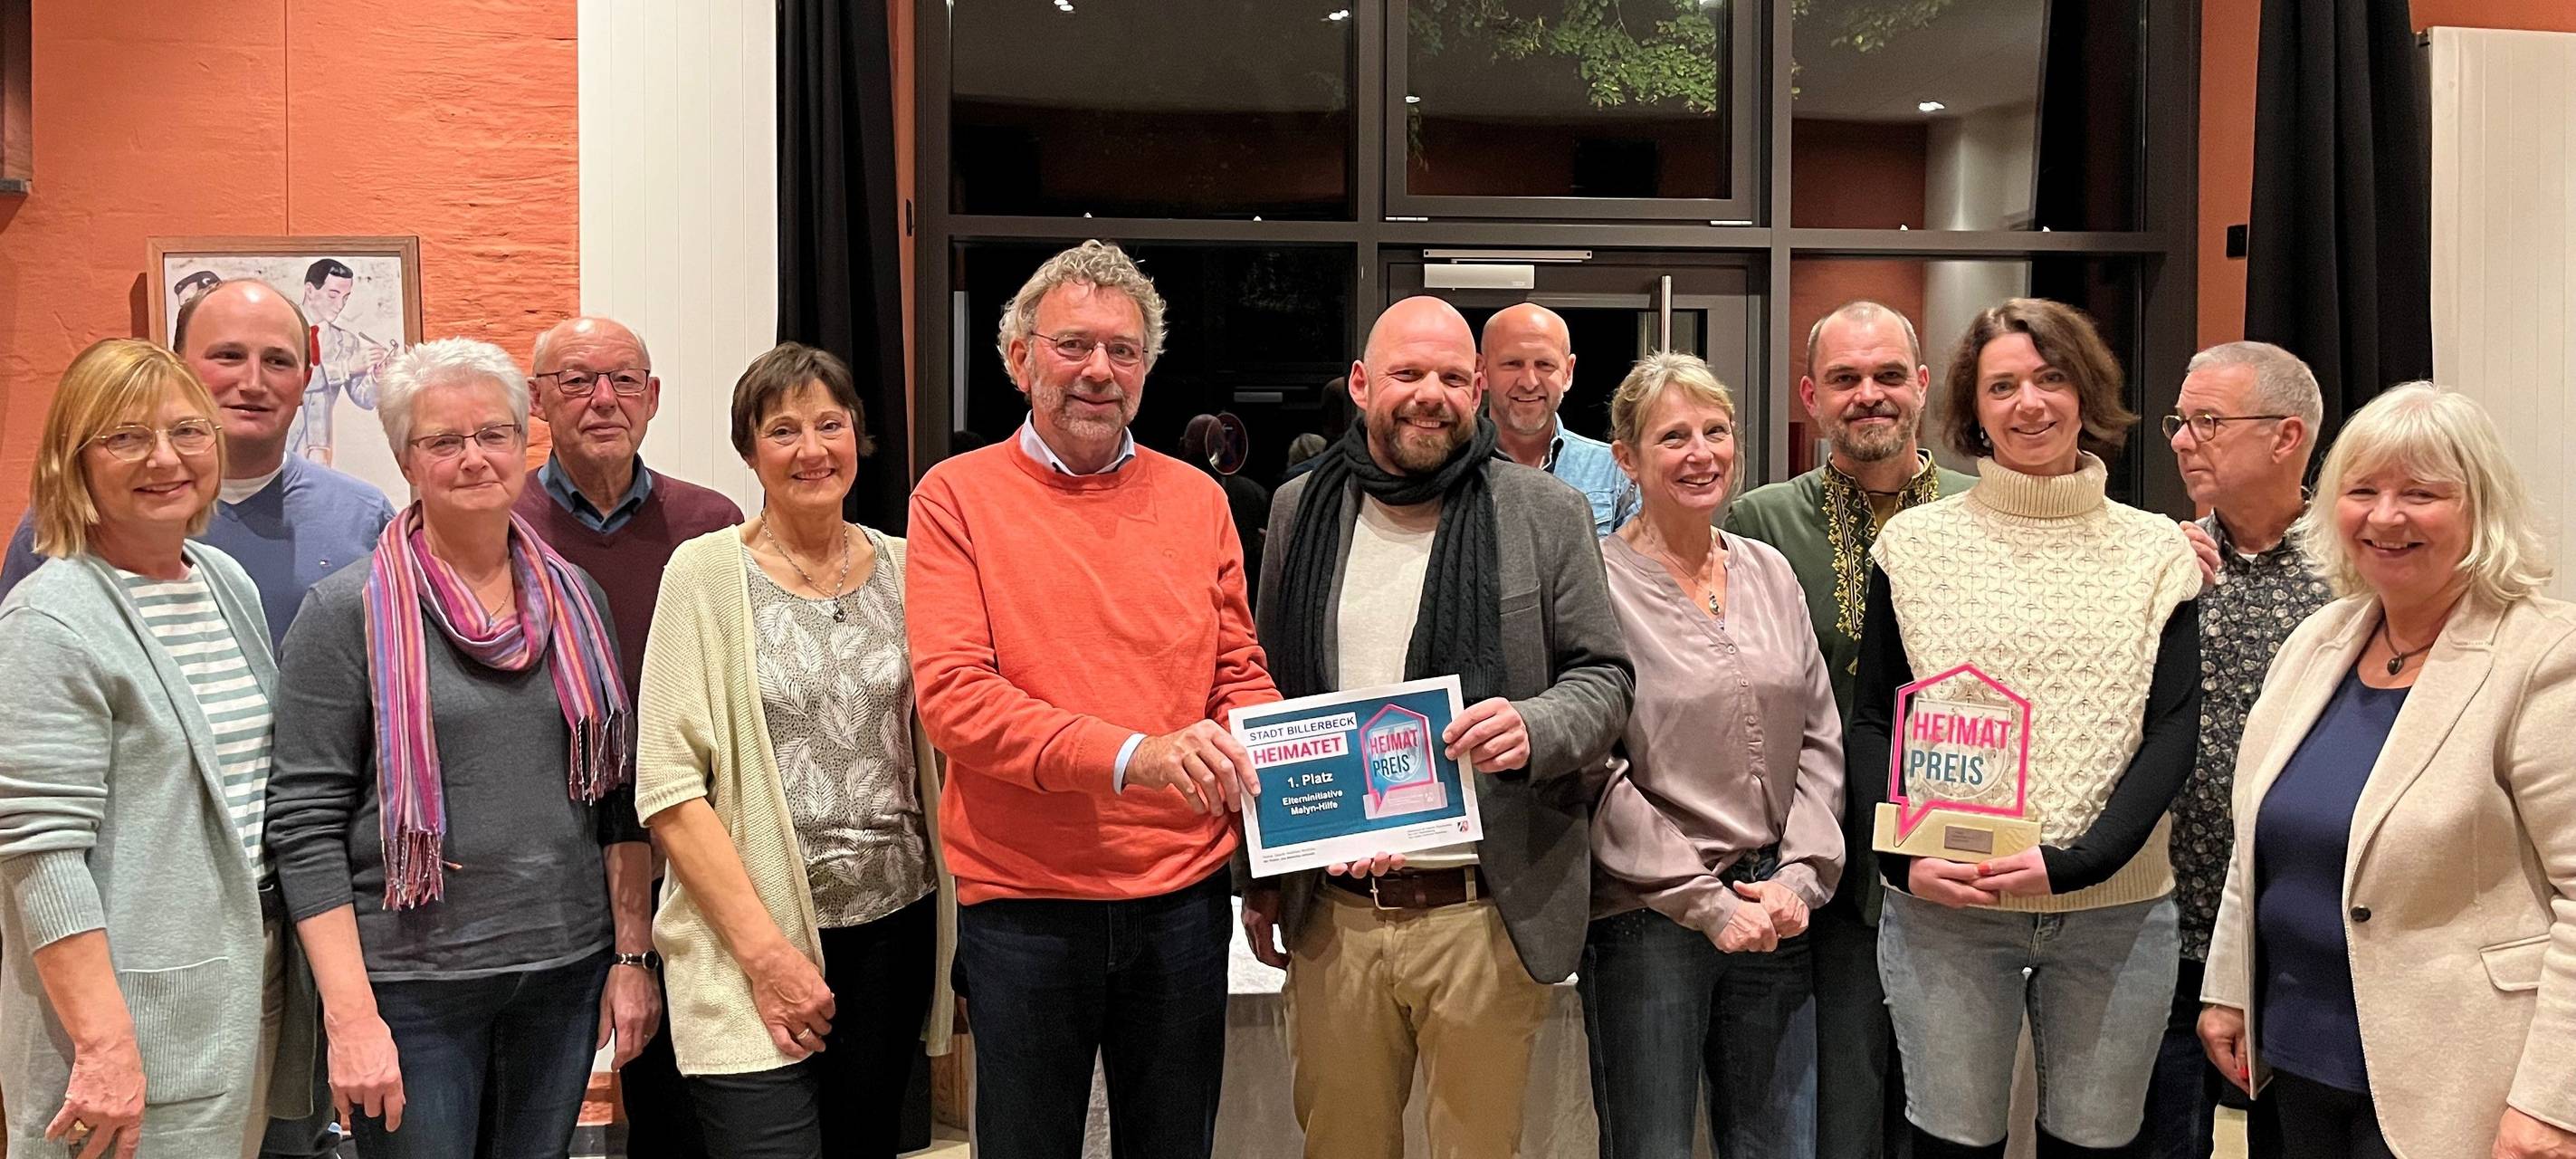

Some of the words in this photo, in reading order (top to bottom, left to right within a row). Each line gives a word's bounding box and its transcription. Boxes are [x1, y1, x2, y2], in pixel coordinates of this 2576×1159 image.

[1250, 728, 1283, 742] STADT
[1287, 716, 1355, 735] BILLERBECK
[1369, 729, 1418, 754] HEIMAT
[1913, 712, 2011, 750] HEIMAT
[1254, 737, 1341, 765] HEIMATET
[1372, 753, 1410, 777] PREIS
[1909, 749, 1984, 786] PREIS
[1287, 777, 1300, 789] 1.
[1302, 771, 1334, 786] Platz
[1282, 790, 1343, 806] Elterninitiative
